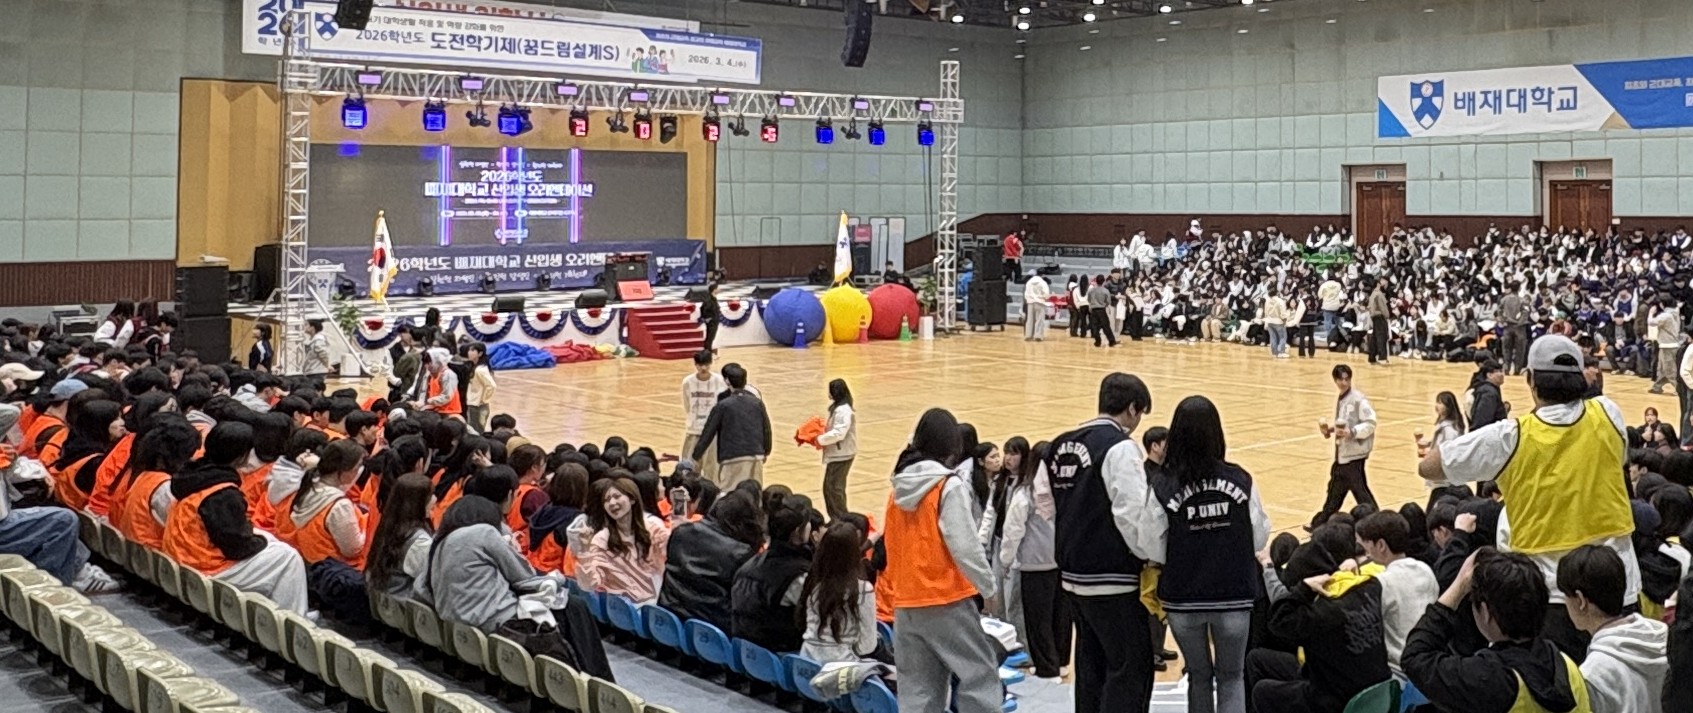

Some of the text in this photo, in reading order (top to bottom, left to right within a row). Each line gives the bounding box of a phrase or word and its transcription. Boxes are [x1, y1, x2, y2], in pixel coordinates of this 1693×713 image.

[355, 30, 620, 62] 2026학년도 도전학기제(꿈드림설계S)
[1453, 86, 1578, 116] 배재대학교
[527, 183, 594, 198] 오리엔테이션
[454, 254, 521, 270] 배재대학교
[524, 252, 562, 268] 신입생
